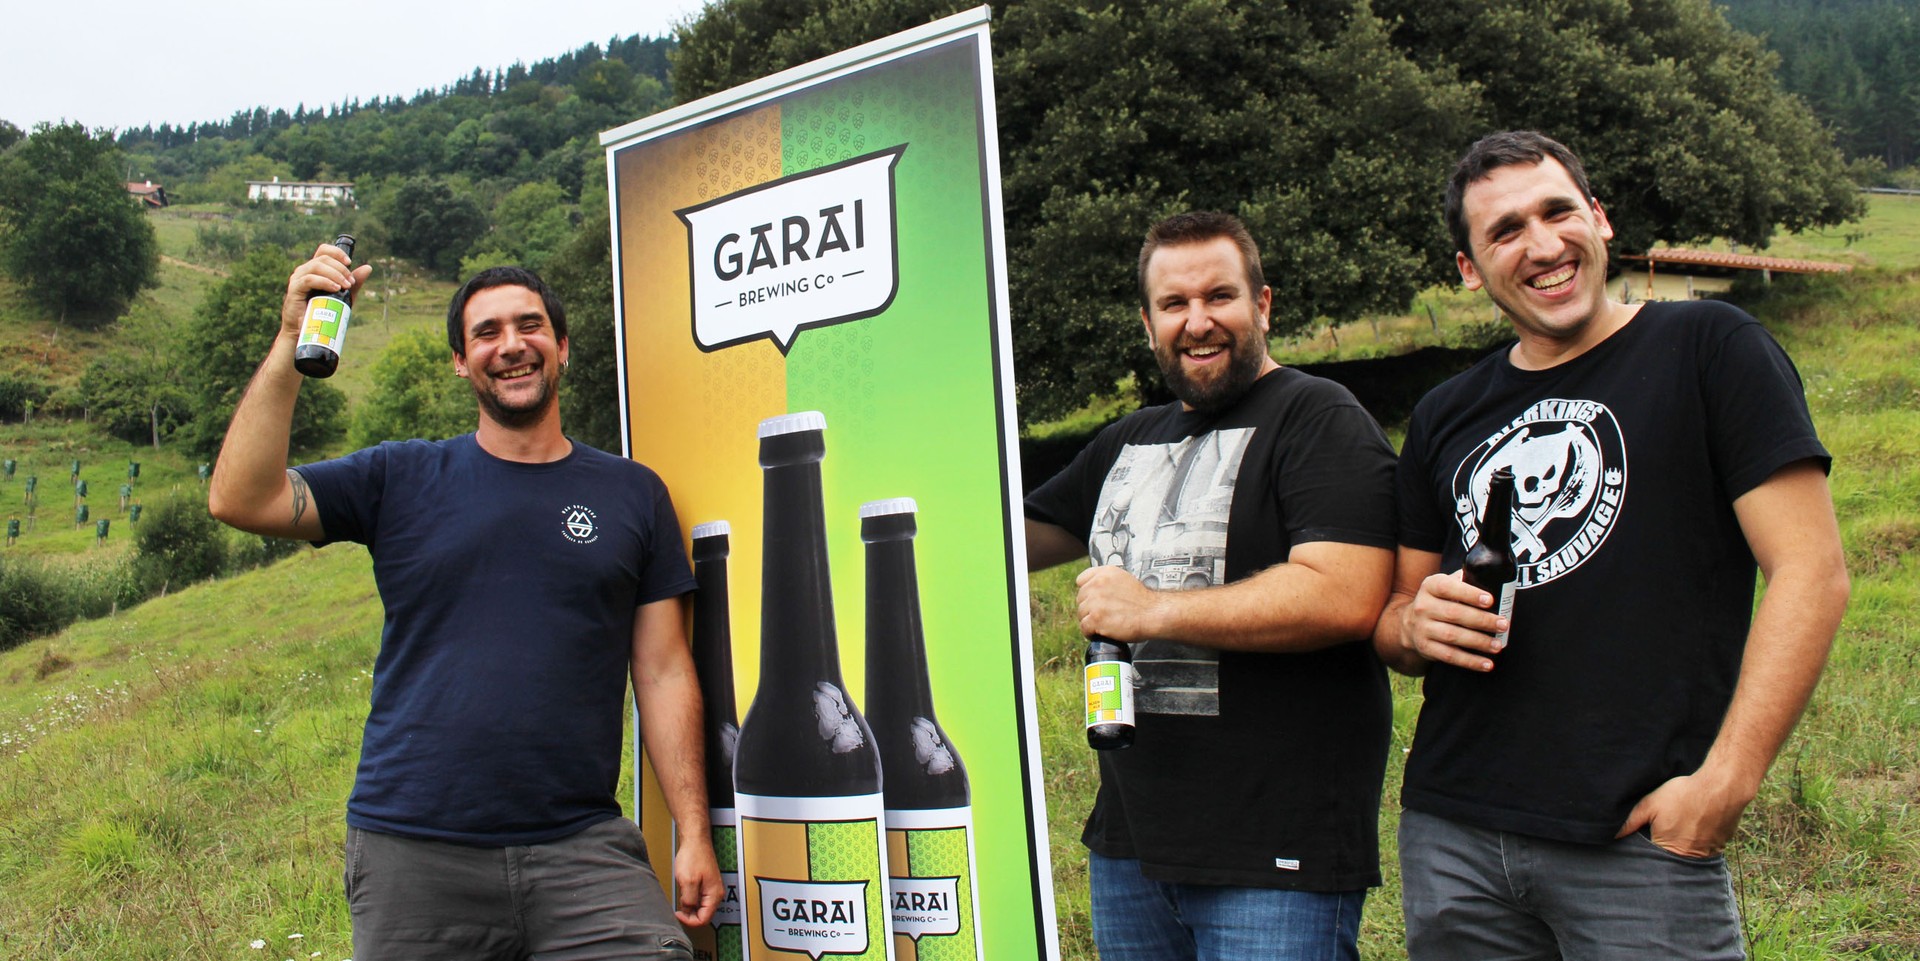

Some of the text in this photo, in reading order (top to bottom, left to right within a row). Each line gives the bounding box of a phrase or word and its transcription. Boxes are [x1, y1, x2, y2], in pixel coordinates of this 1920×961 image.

[714, 199, 865, 282] GARAI
[738, 274, 834, 308] BREWING Co
[1536, 486, 1621, 582] SAUVAGE
[772, 897, 855, 924] GARAI
[892, 915, 926, 923] BREWING
[788, 928, 841, 938] BREWING Co
